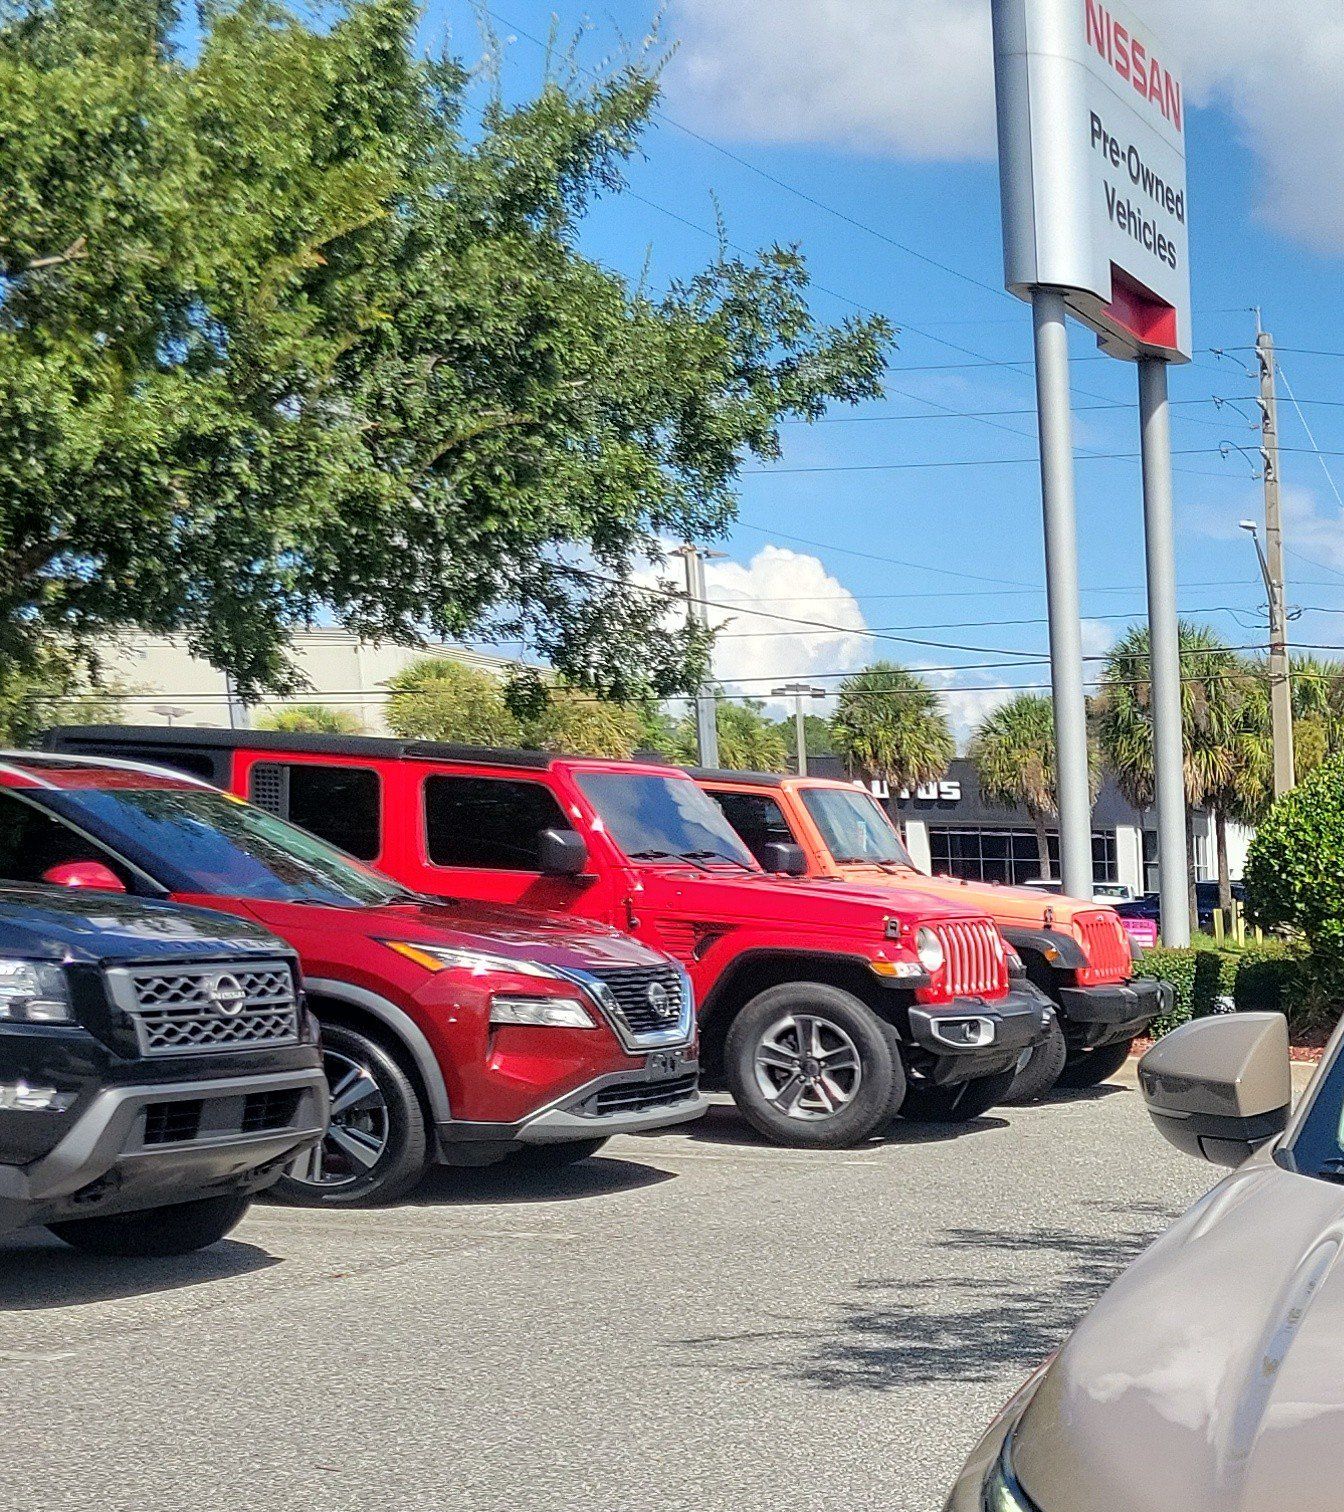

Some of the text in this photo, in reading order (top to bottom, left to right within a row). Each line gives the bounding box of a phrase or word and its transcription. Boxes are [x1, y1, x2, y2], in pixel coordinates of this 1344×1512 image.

[1085, 0, 1182, 132] NISSAN
[1090, 110, 1184, 225] Pre-Owned
[1103, 180, 1176, 270] Vehicles
